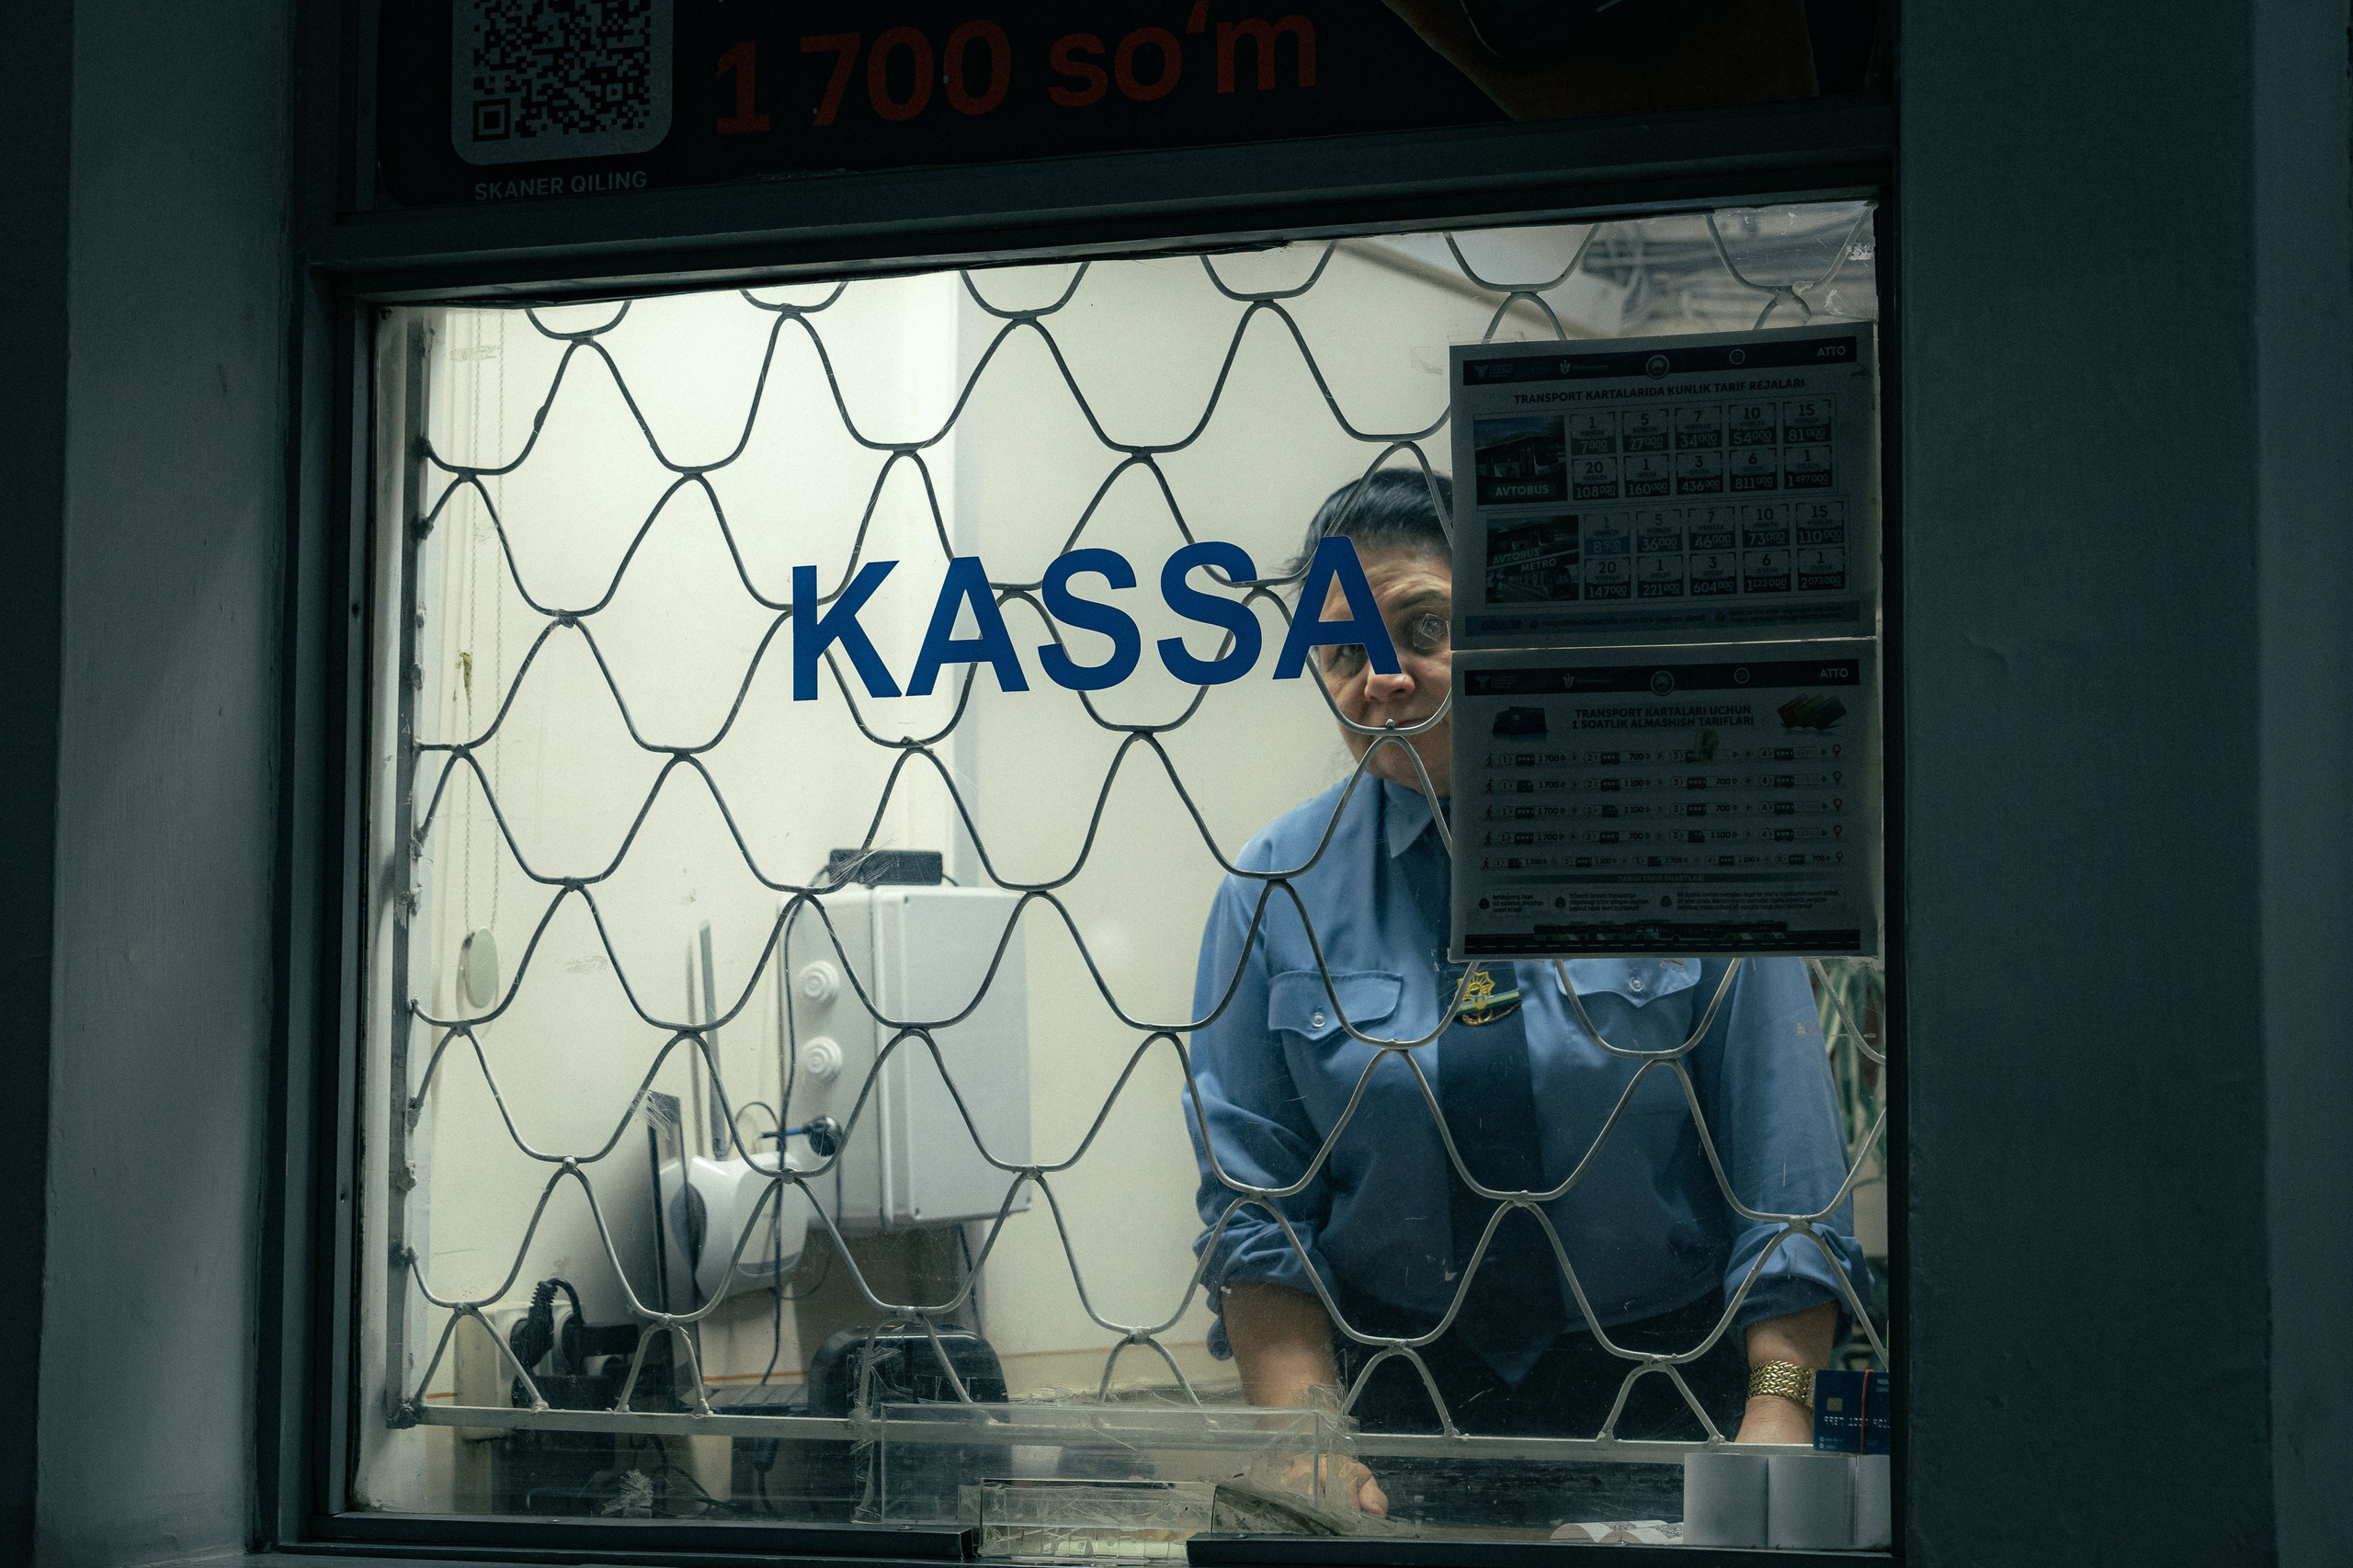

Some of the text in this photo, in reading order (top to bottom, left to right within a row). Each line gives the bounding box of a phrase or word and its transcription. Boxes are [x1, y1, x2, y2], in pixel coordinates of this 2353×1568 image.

[716, 41, 770, 134] 1
[800, 19, 1011, 128] 700
[474, 170, 647, 201] SKANER QILING
[1816, 346, 1846, 358] ATTO
[1514, 378, 1805, 404] TRANSPORT KARTALARIDA KUNLIK TARIF REJALARI
[1744, 407, 1761, 419] 10
[1799, 404, 1814, 416] 15
[1589, 416, 1596, 428] 1
[1641, 414, 1649, 426] 5
[1694, 410, 1702, 423] 7
[1680, 433, 1717, 448] 34000
[1733, 430, 1772, 444] 54000
[1580, 440, 1608, 454] 7000
[1629, 437, 1663, 450] 27000
[1749, 452, 1757, 465] 6
[1804, 449, 1811, 461] 1
[1586, 461, 1603, 474] 20
[1643, 459, 1650, 471] 1
[1695, 456, 1703, 468] 3
[1629, 483, 1667, 495] 160000
[1682, 480, 1720, 492] 436000
[1735, 477, 1773, 489] 811000
[1495, 484, 1550, 496] AVTOBUS
[1576, 485, 1616, 498] 108000
[1708, 511, 1716, 523] 7
[1756, 508, 1773, 520] 10
[1812, 506, 1827, 518] 15
[1604, 517, 1610, 528] 1
[1654, 514, 1663, 526] 5
[1643, 537, 1677, 551] 36000
[1695, 535, 1731, 548] 46000
[1748, 532, 1785, 546] 73000
[1492, 548, 1540, 564] AVTOBUS
[1762, 553, 1771, 566] 6
[1817, 551, 1824, 563] 1
[1520, 558, 1557, 573] METRO
[1598, 562, 1617, 574] 20
[1657, 559, 1664, 572] 1
[1709, 556, 1717, 569] 3
[1588, 585, 1627, 597] 147000
[1643, 584, 1680, 596] 221000
[1694, 581, 1733, 593] 604000
[792, 535, 1402, 701] KASSA
[1820, 667, 1848, 679] ATTO
[1574, 705, 1751, 719] TRANSPORT KARTALARI UCHUN
[1572, 716, 1754, 729] 1 SOATLIK ALMASHISH TARIFLARI
[1715, 804, 1731, 812] 700
